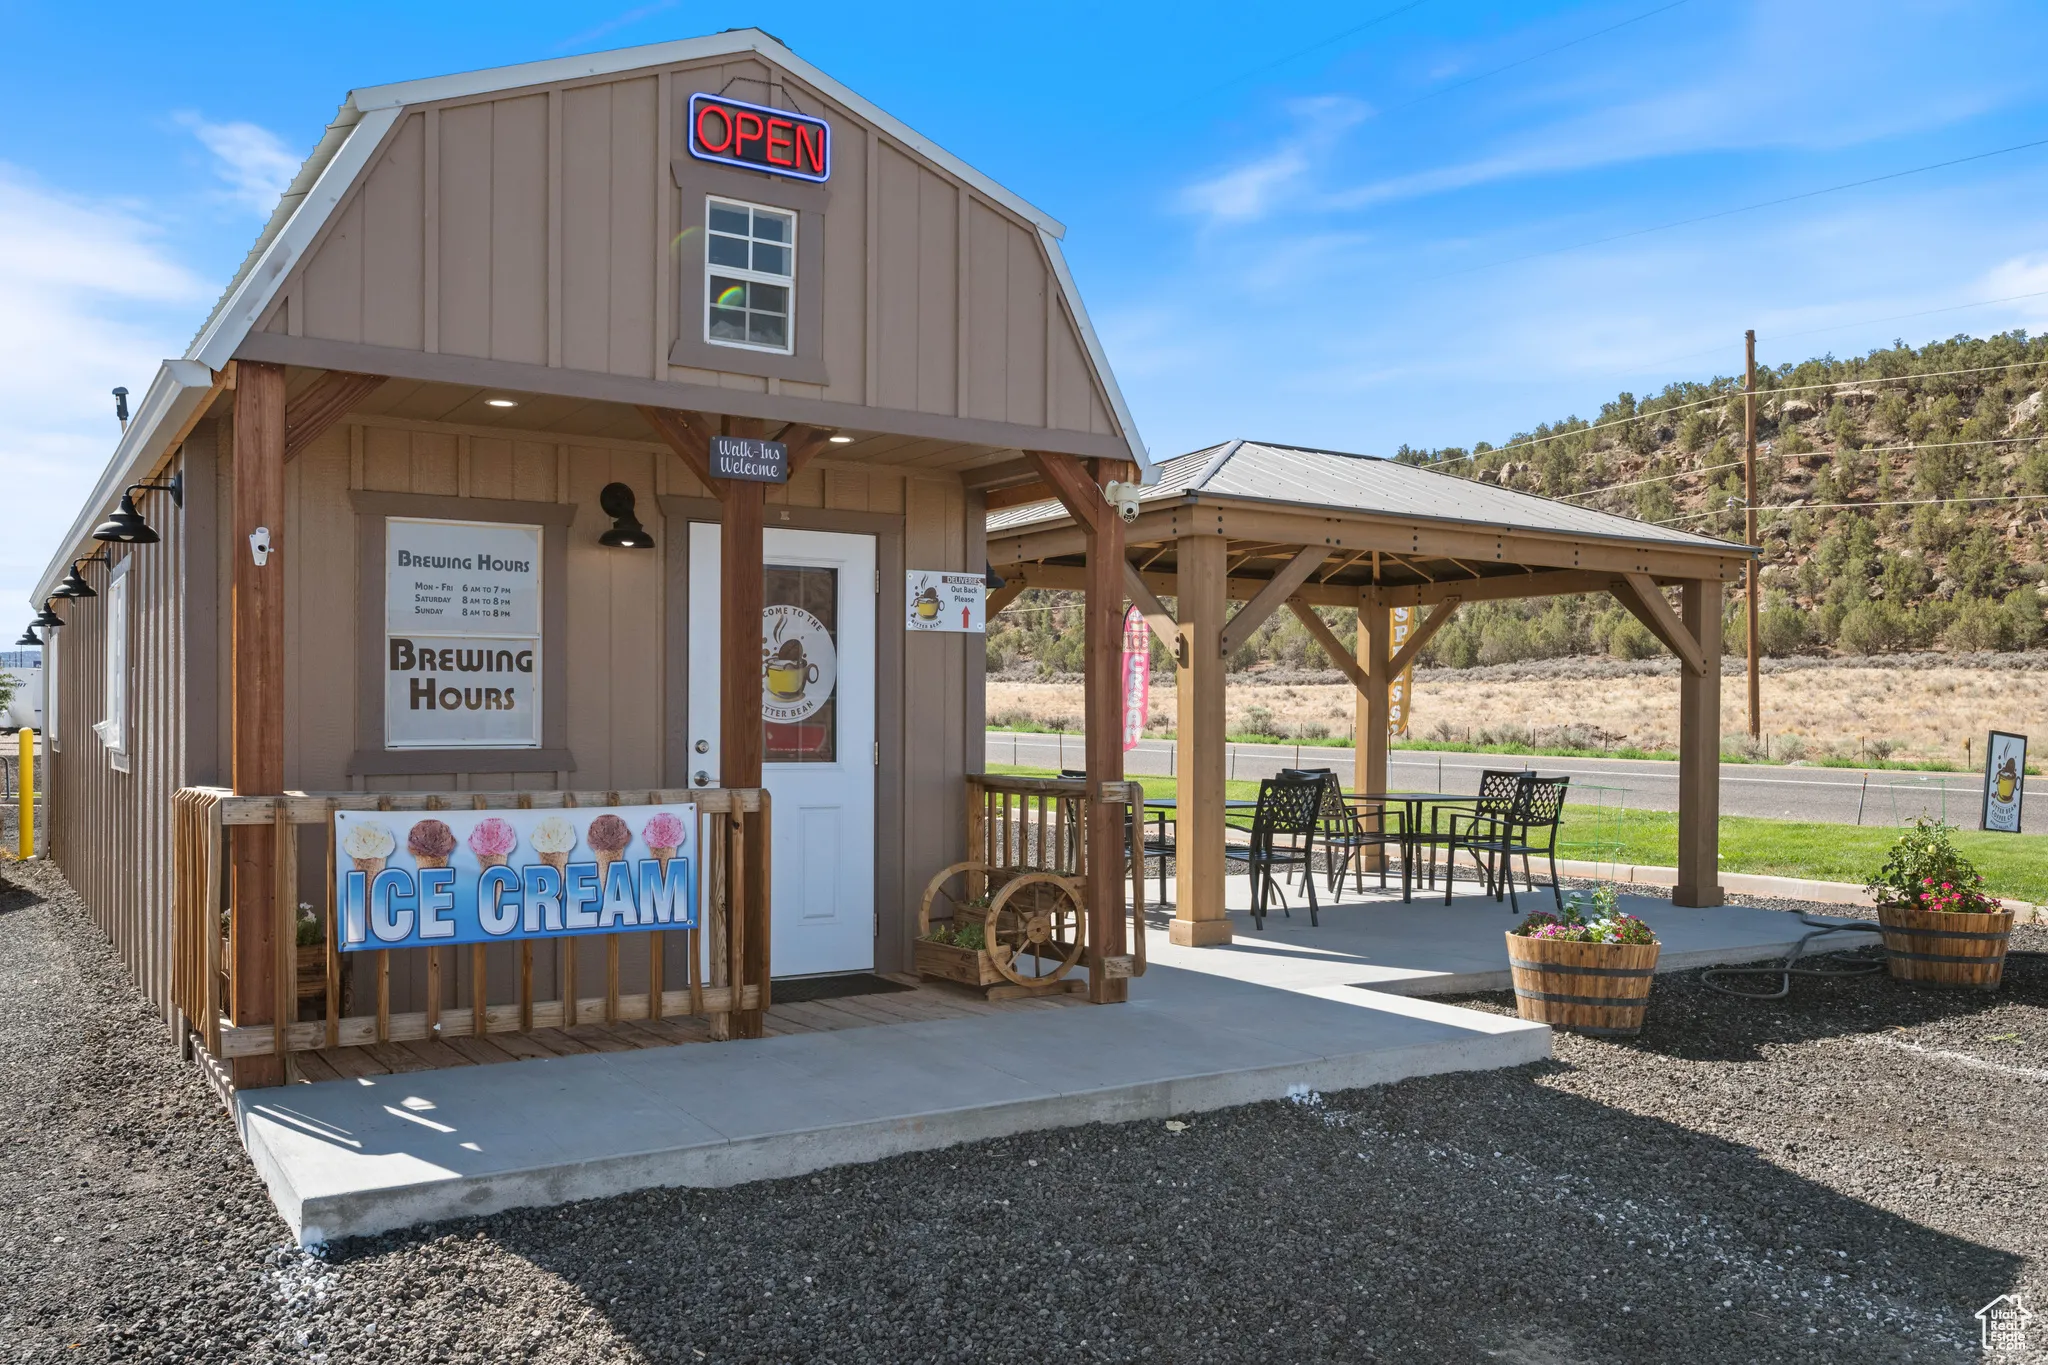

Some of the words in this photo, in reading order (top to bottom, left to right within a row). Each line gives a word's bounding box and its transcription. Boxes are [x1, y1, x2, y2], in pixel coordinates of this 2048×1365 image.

[696, 105, 824, 173] OPEN
[719, 440, 780, 460] Walk-Ins
[720, 457, 780, 477] Welcome
[947, 576, 981, 585] DELIVERIES
[462, 584, 468, 592] 6
[493, 586, 499, 594] 7
[951, 585, 962, 593] Out
[963, 586, 978, 594] Back
[462, 596, 468, 604] 8
[493, 597, 499, 605] 8
[954, 595, 975, 603] Please
[462, 608, 468, 616] 8
[493, 609, 499, 617] 8
[792, 608, 804, 618] TO
[806, 614, 823, 632] THE
[911, 618, 928, 629] BITTER
[929, 619, 943, 629] BEAN
[1126, 634, 1149, 650] ICE
[762, 704, 787, 717] TTER
[790, 700, 814, 717] BEAN
[1991, 801, 2004, 814] BITTER
[2005, 803, 2017, 814] BEAN
[346, 867, 456, 943] ICE
[478, 857, 689, 936] CREAM
